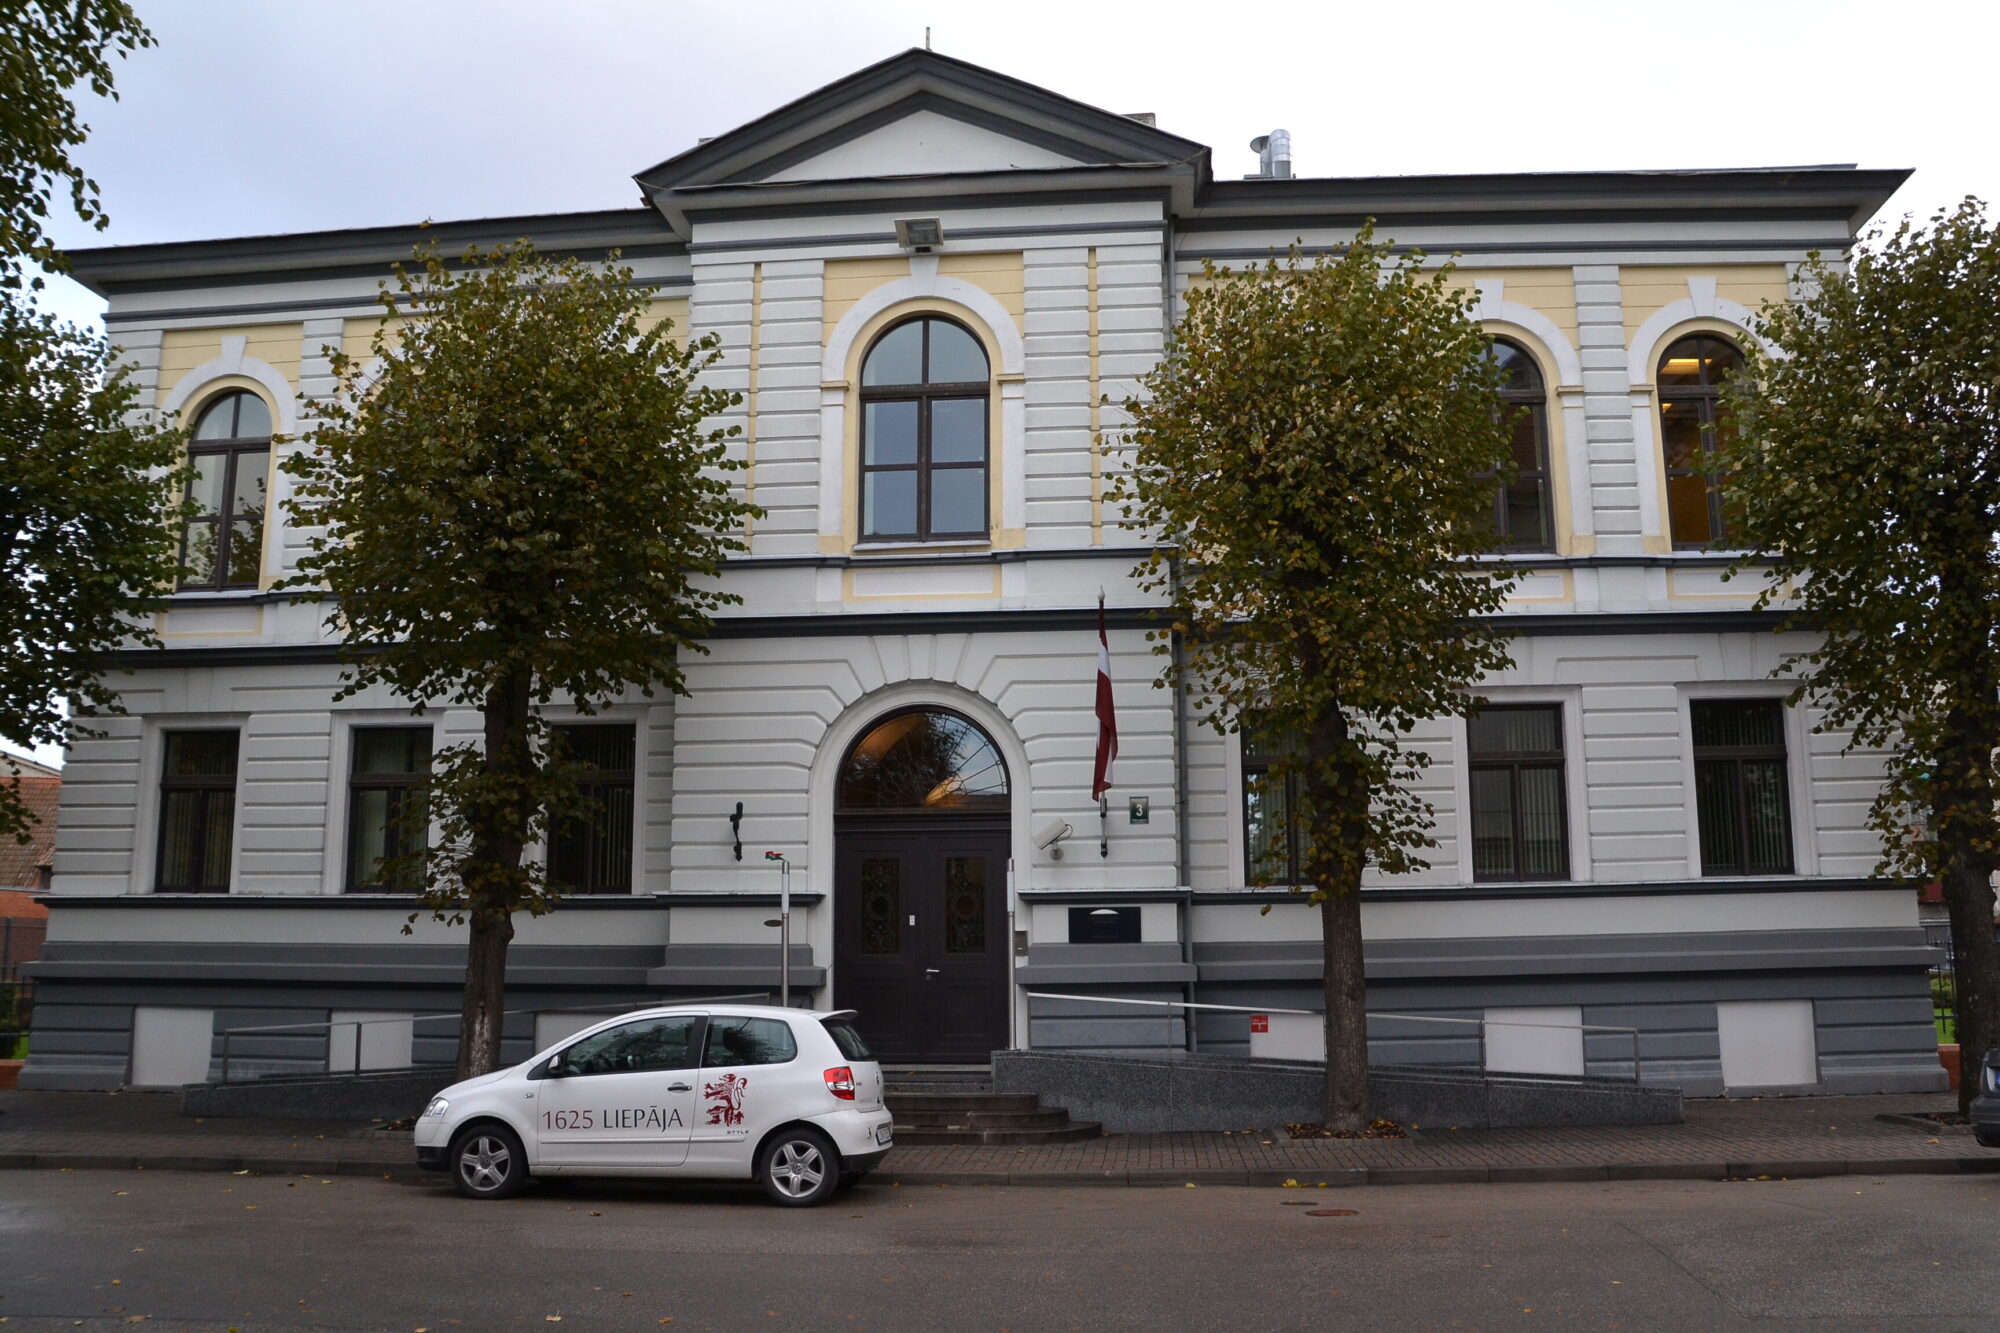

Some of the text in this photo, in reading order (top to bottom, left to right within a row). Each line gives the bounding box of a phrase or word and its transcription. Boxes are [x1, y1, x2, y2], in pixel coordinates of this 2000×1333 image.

[1136, 804, 1143, 817] 3
[542, 1105, 683, 1133] 1625 LIEPĀJA
